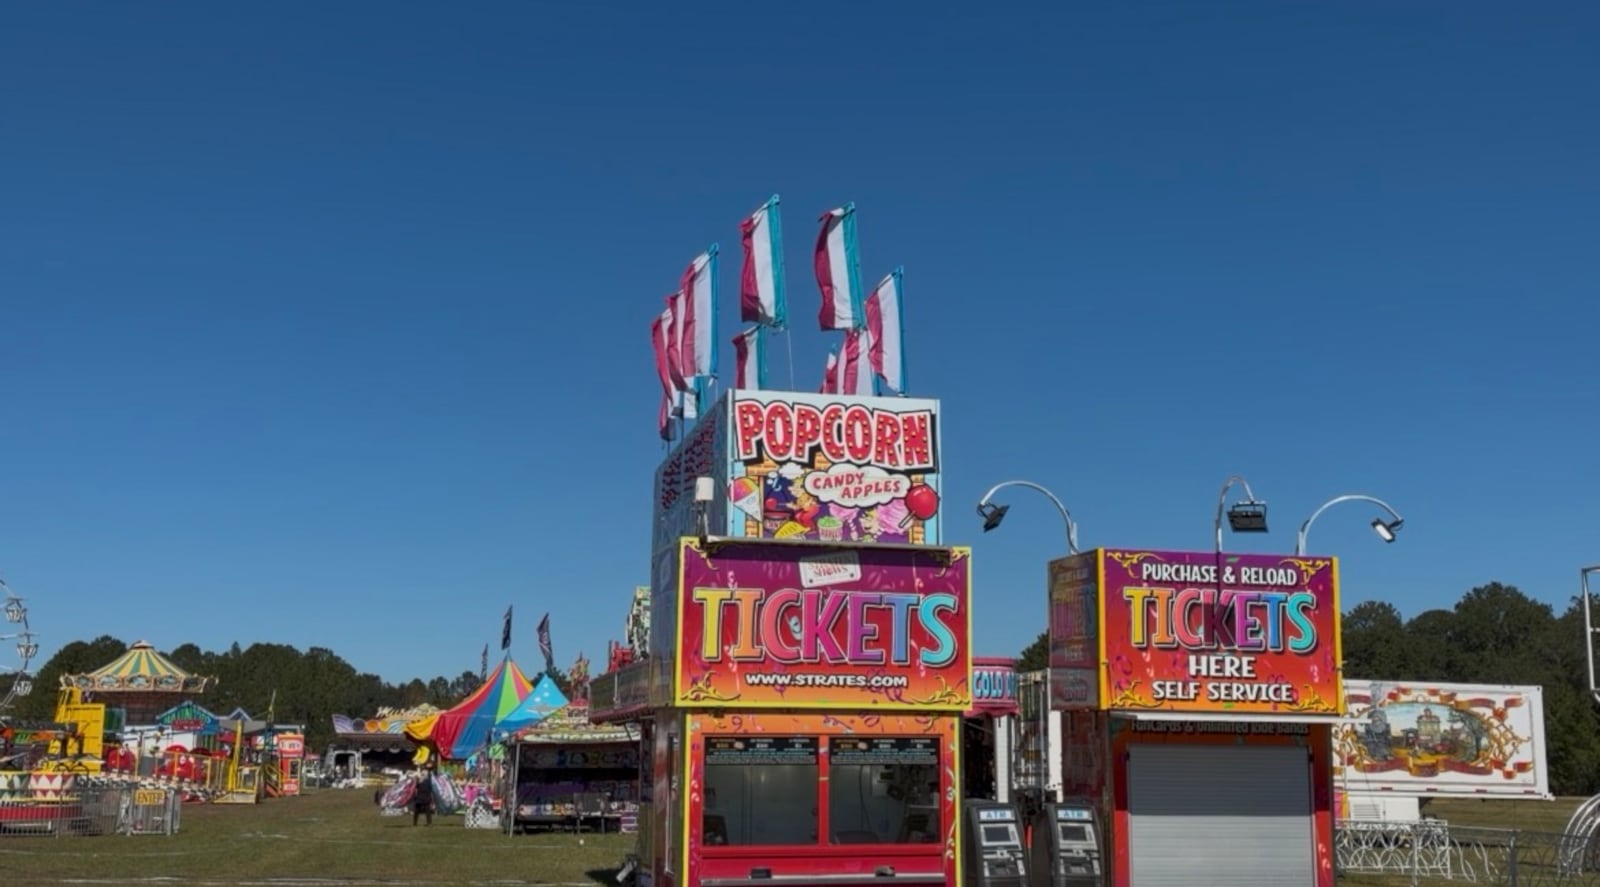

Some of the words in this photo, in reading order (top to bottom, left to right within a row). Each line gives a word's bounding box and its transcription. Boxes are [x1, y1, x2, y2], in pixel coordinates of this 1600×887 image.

[734, 400, 934, 469] POPCORN
[812, 472, 865, 490] CANDY
[841, 480, 901, 499] APPLES
[1142, 564, 1218, 583] PURCHASE
[1223, 567, 1236, 583] &
[1241, 568, 1297, 586] RELOAD
[693, 587, 959, 668] TICKETS
[1123, 586, 1318, 653] TICKETS
[1188, 655, 1257, 678] HERE
[746, 673, 907, 688] WWW.STRATES.COM
[973, 671, 1004, 699] COLD
[1152, 681, 1200, 700] SELF
[1207, 683, 1293, 702] SERVICE
